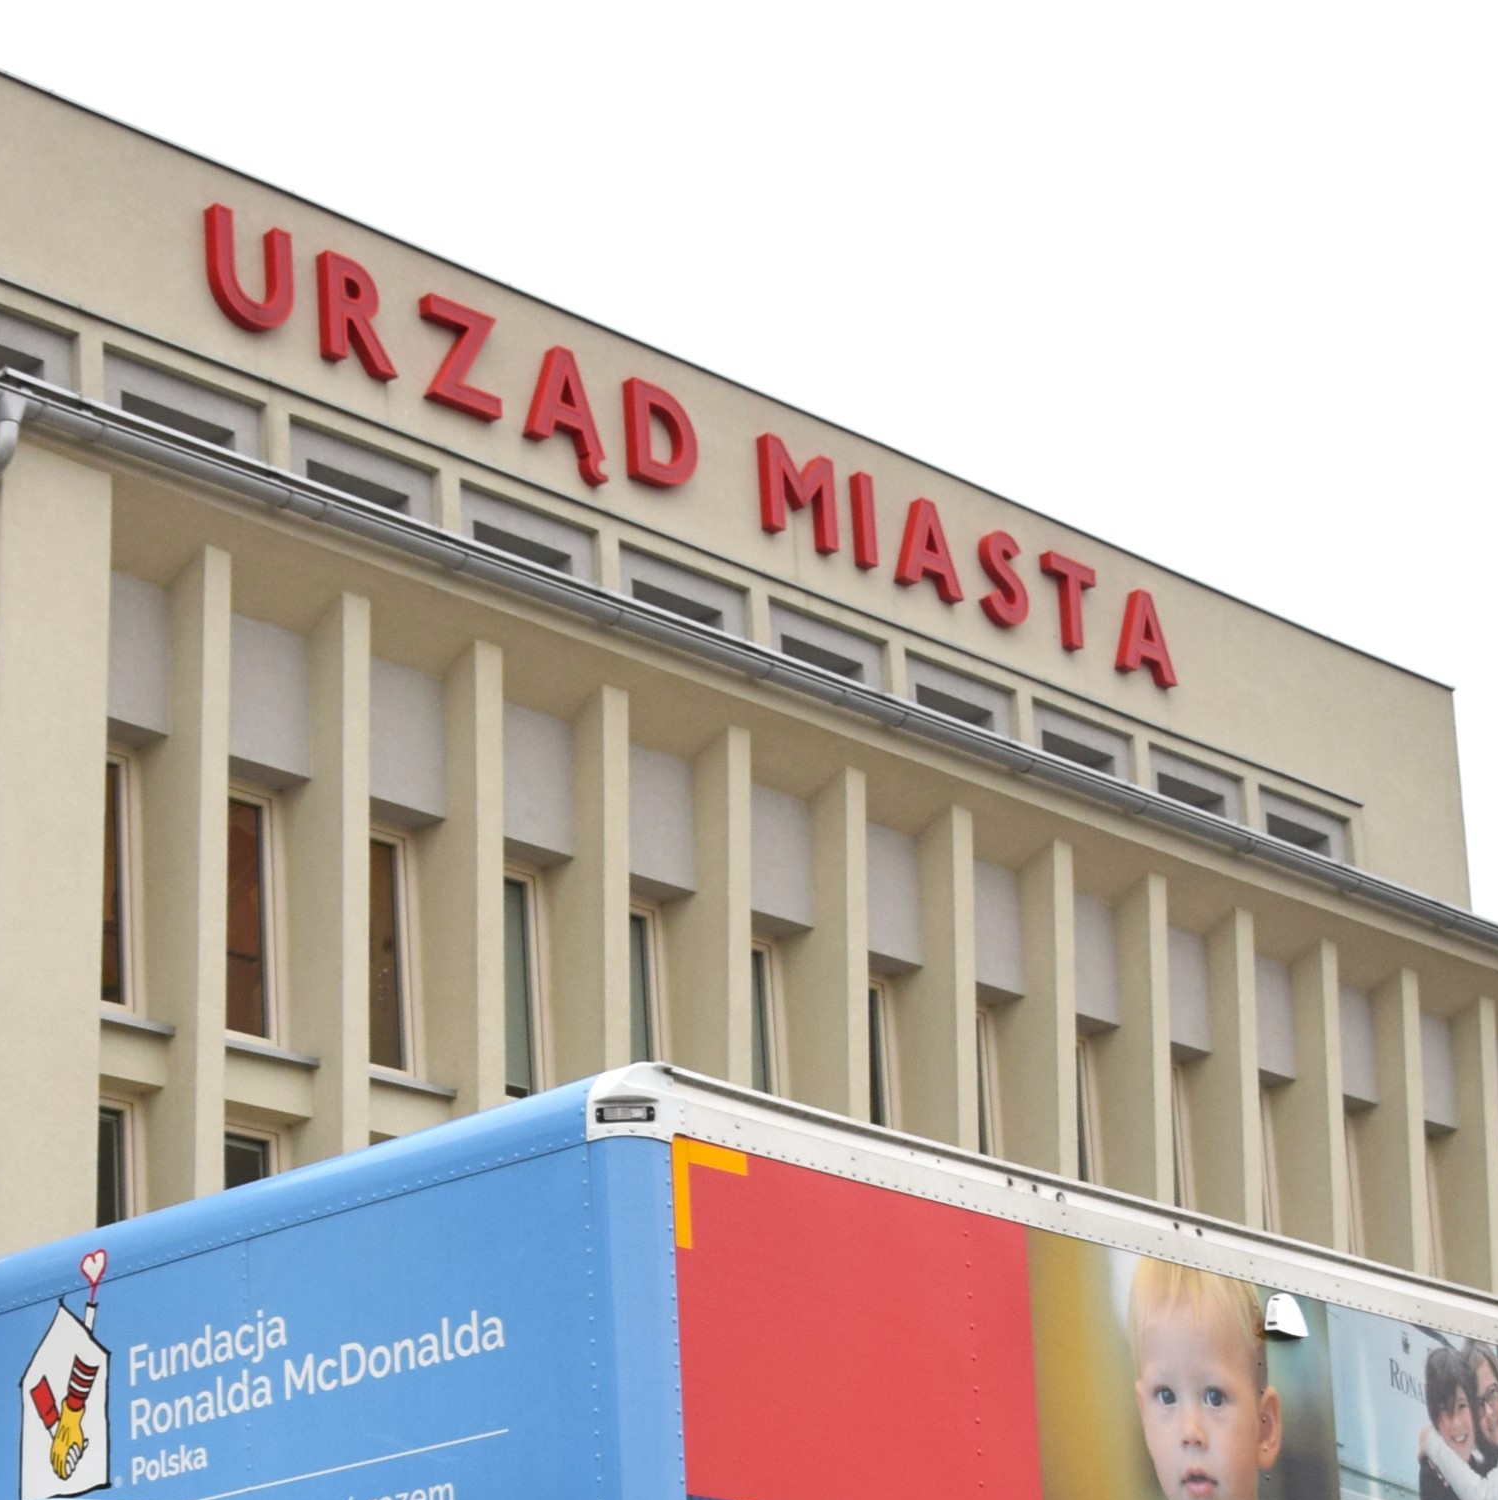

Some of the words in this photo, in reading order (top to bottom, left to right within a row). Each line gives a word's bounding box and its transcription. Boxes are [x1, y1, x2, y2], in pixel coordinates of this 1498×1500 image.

[202, 202, 699, 488] URZĄD
[754, 430, 1179, 690] MIASTA
[128, 1309, 288, 1387] Fundacja
[129, 1366, 273, 1440] Ronalda
[282, 1309, 506, 1400] McDonalda
[131, 1443, 209, 1486] Polska
